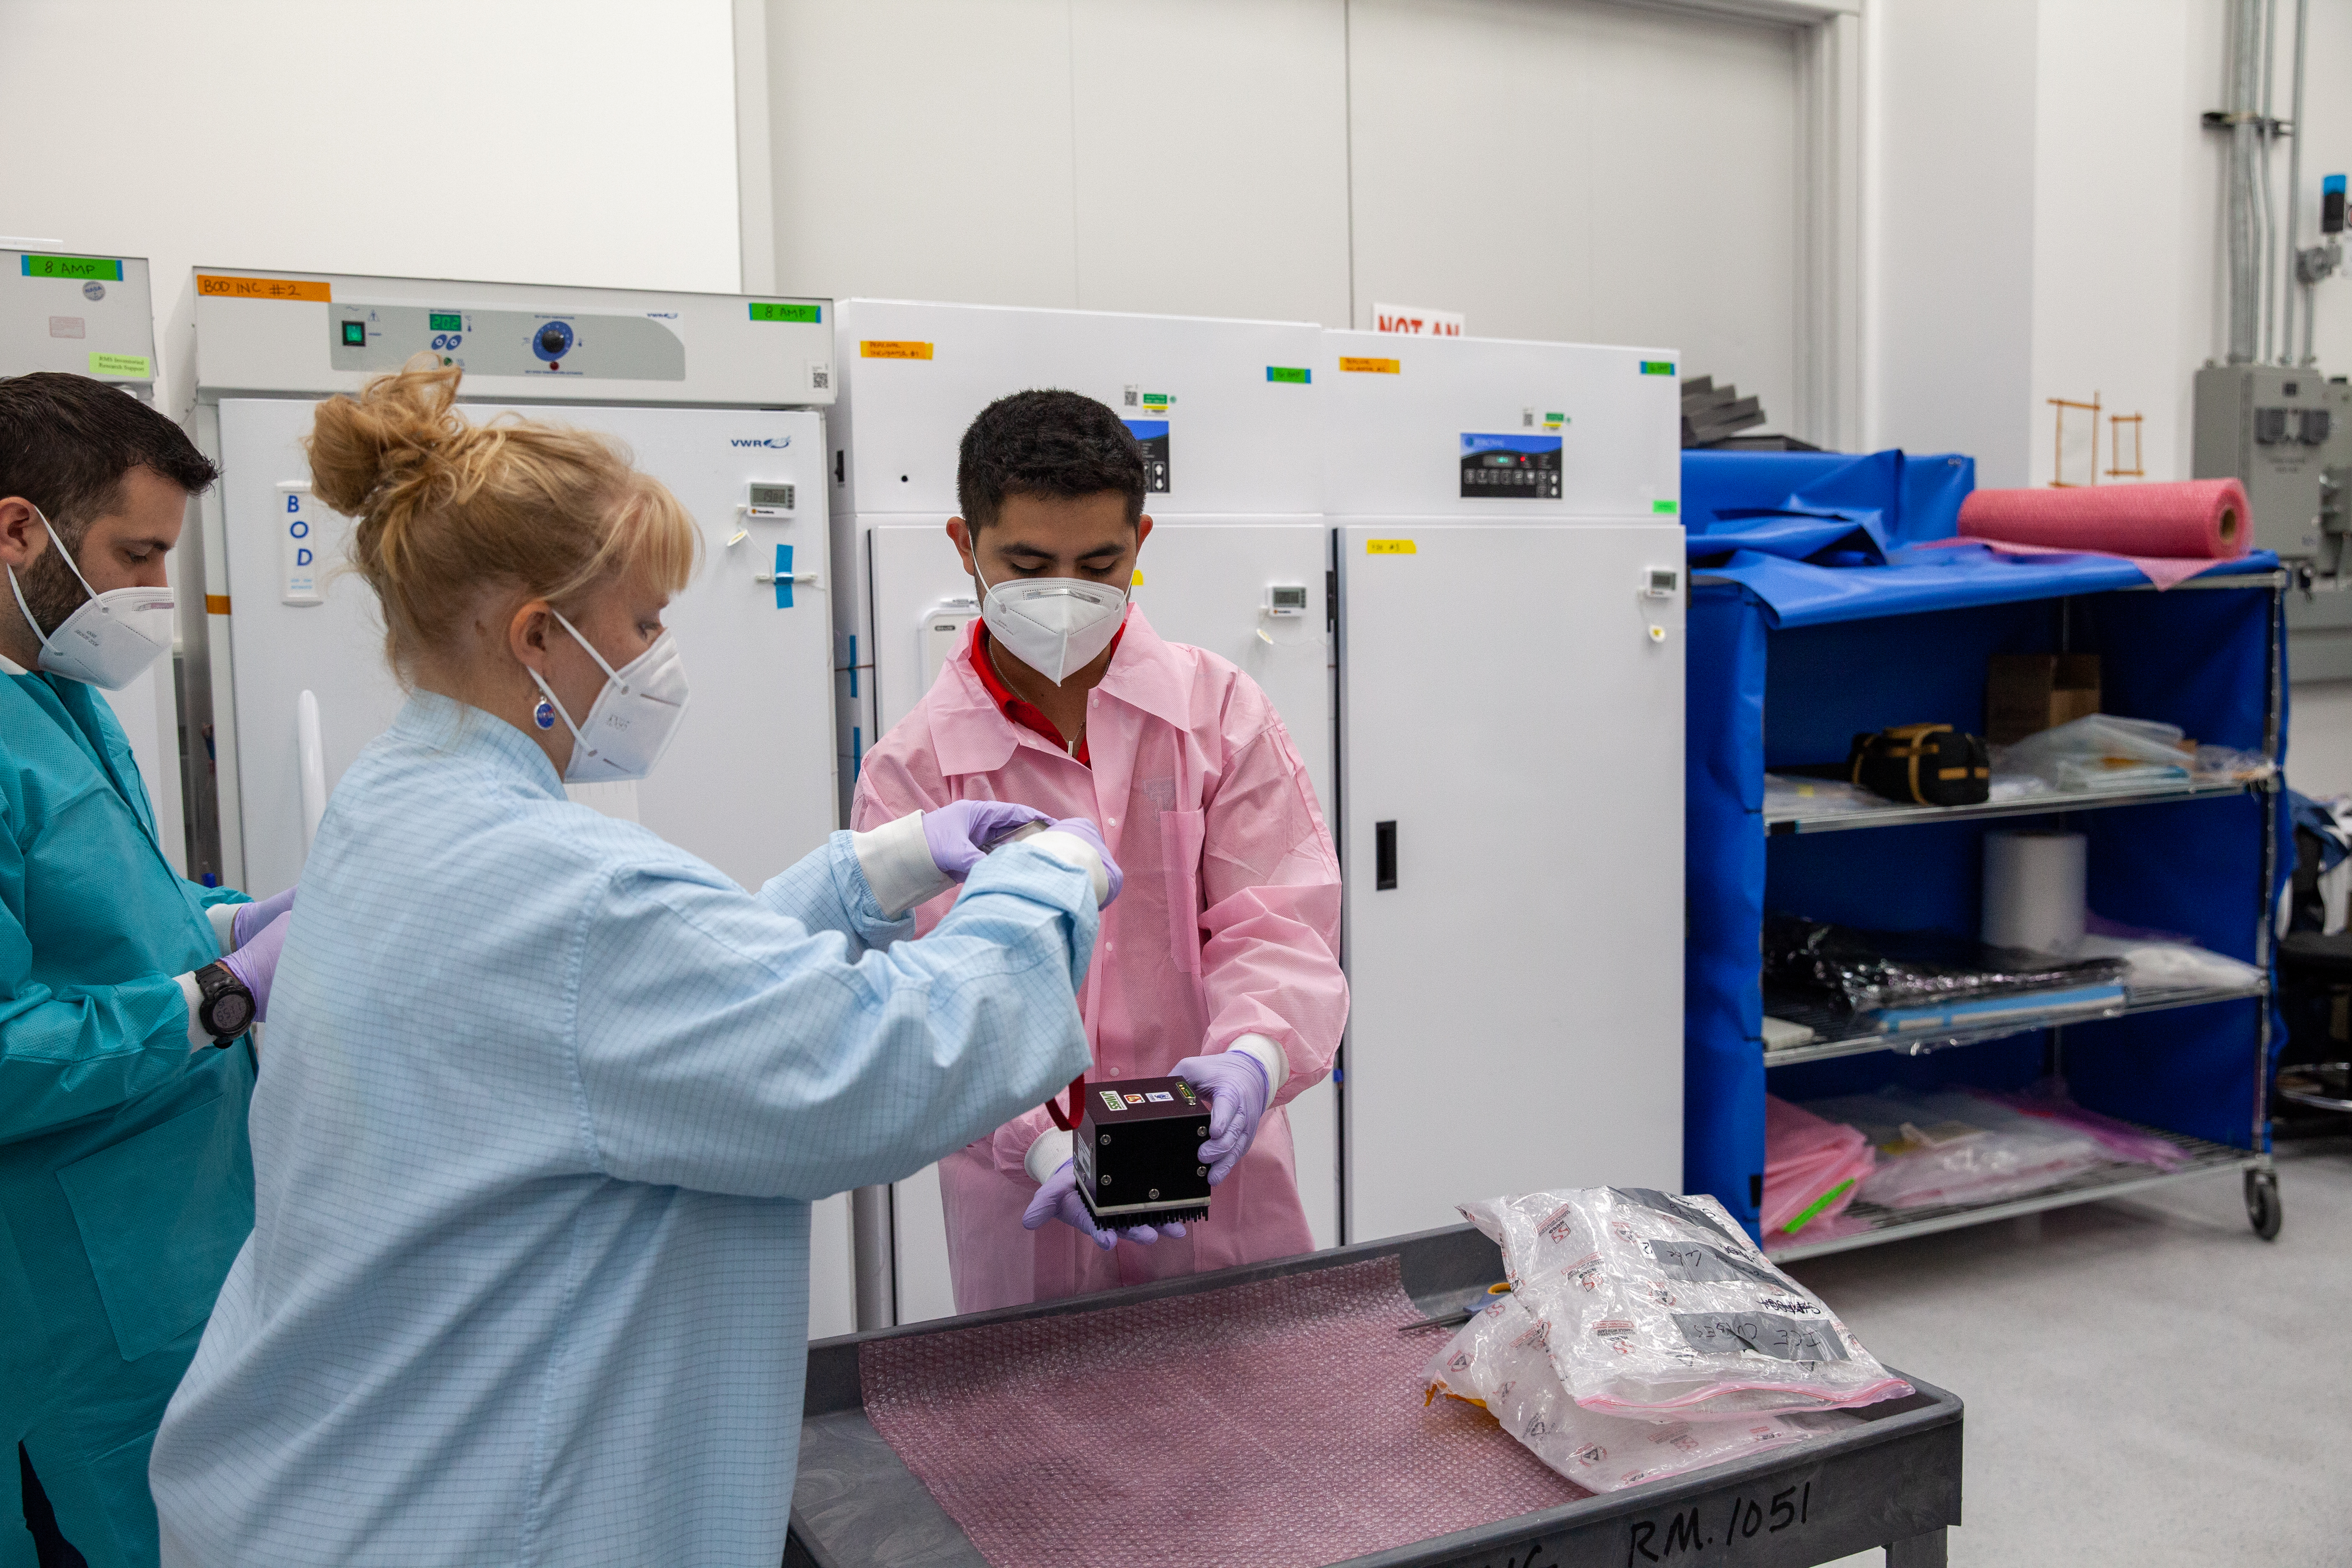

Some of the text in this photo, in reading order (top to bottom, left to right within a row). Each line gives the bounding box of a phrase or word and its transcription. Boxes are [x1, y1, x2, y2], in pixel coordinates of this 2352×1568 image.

[45, 260, 95, 275] 8 AMP
[204, 279, 230, 293] BOD
[236, 281, 262, 294] INC
[765, 305, 806, 318] 8 AMP
[1773, 1328, 1821, 1346] ICE
[1627, 1481, 1810, 1568] RM. 1051
